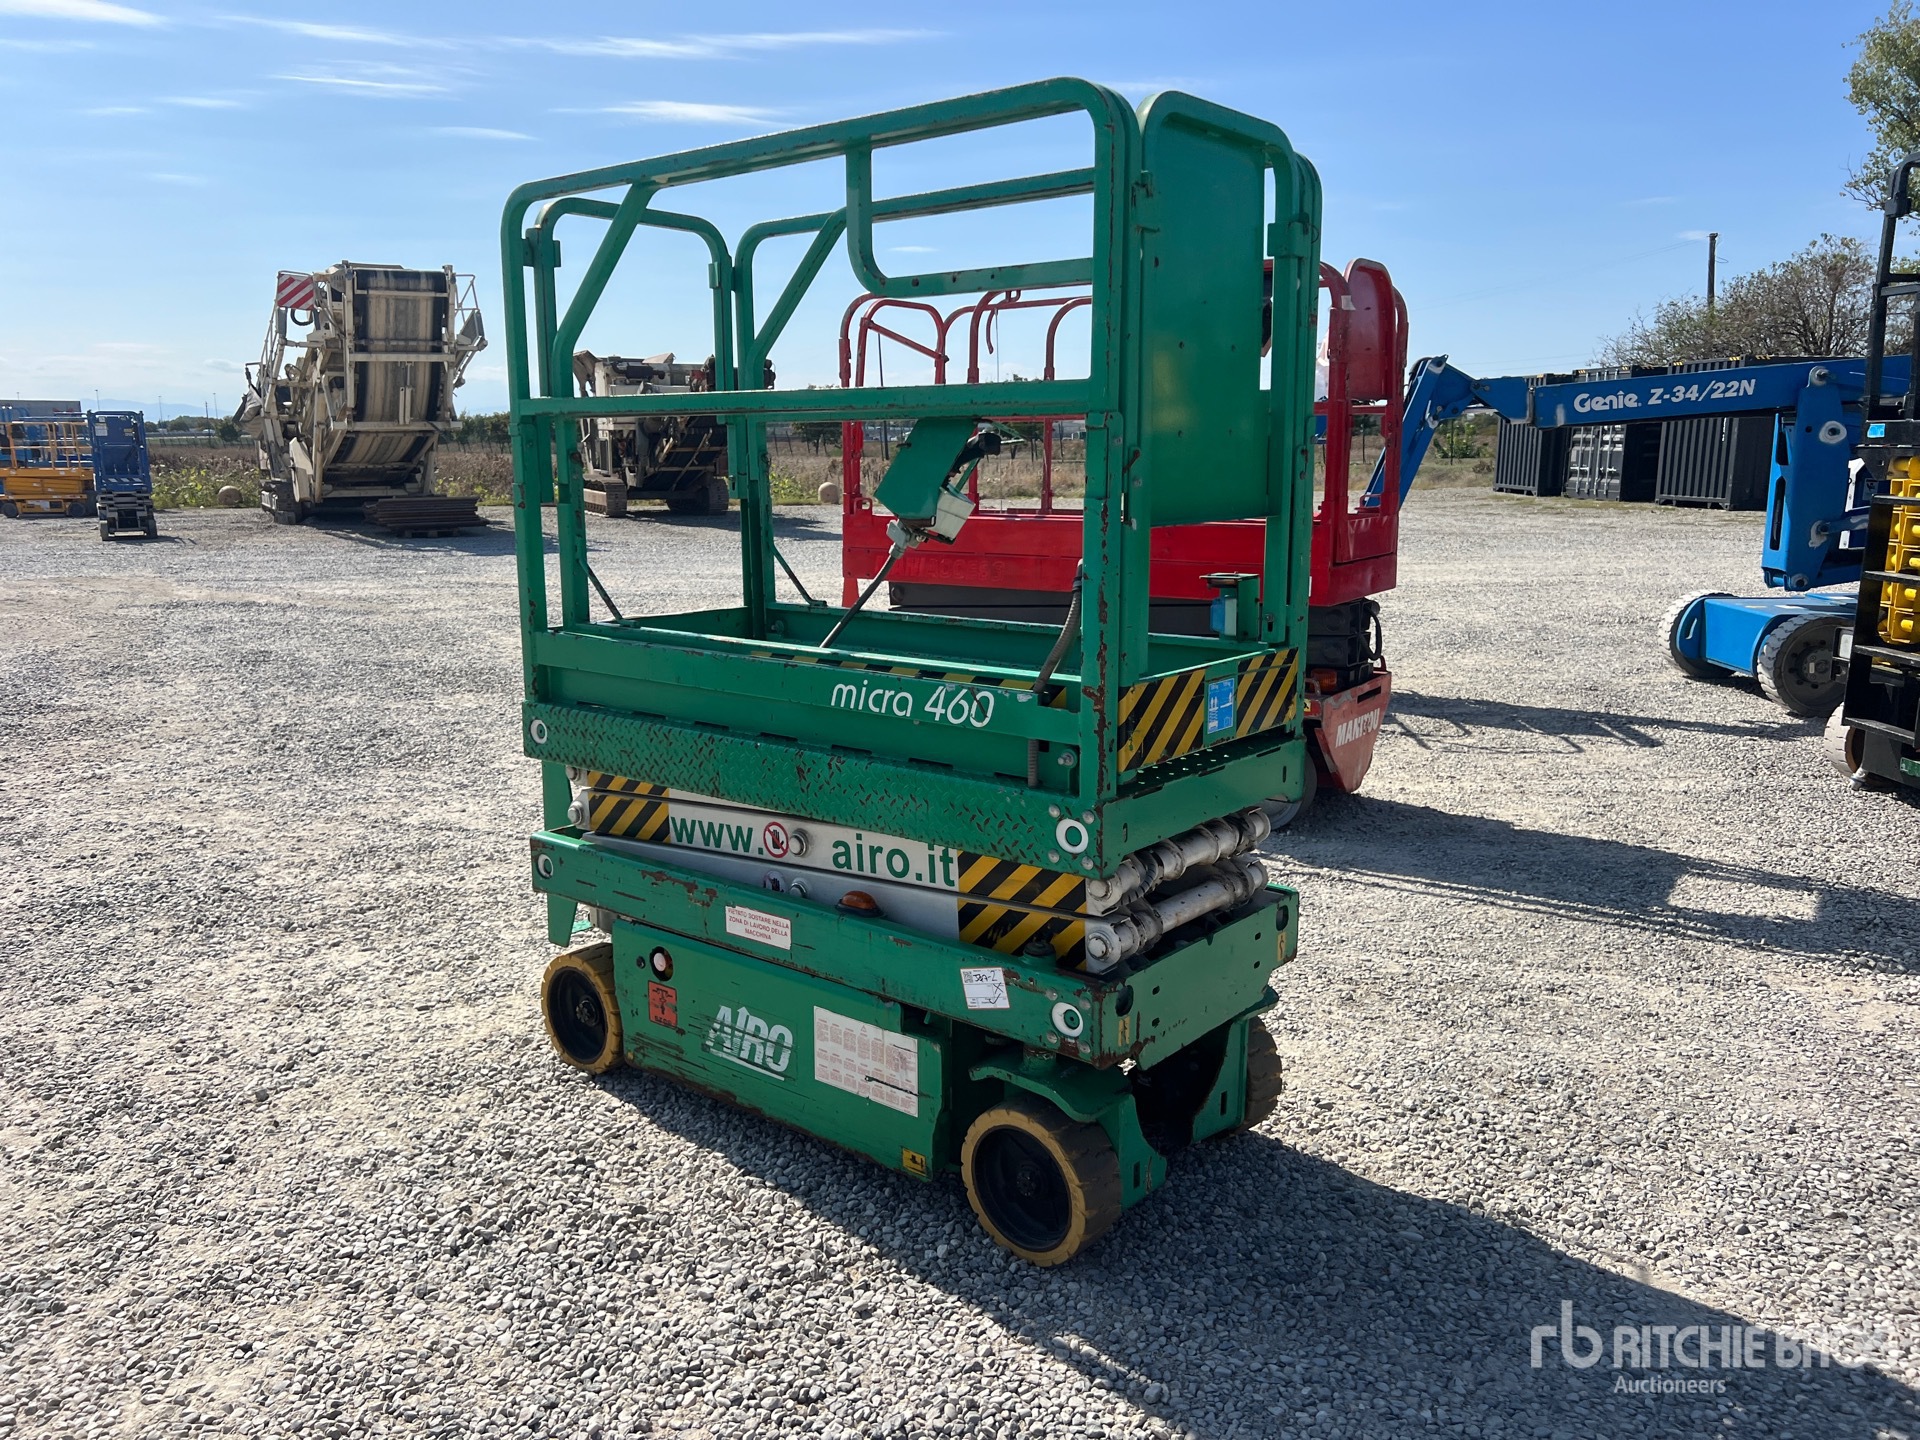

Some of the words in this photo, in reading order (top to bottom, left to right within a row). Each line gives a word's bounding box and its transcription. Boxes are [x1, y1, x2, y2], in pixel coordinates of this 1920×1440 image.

[1573, 390, 1640, 413] Genie
[1647, 379, 1756, 405] Z-34/22N
[830, 679, 913, 718] micra
[924, 685, 995, 728] 460
[670, 816, 764, 855] www.
[832, 832, 956, 887] airo.it
[729, 915, 743, 924] ZONA
[750, 921, 771, 932] LAVORO
[771, 927, 788, 937] DELLA
[745, 928, 772, 940] MACCHINA
[748, 912, 772, 925] SOSTARE
[772, 920, 790, 930] NELLA
[705, 1005, 793, 1072] AIRO
